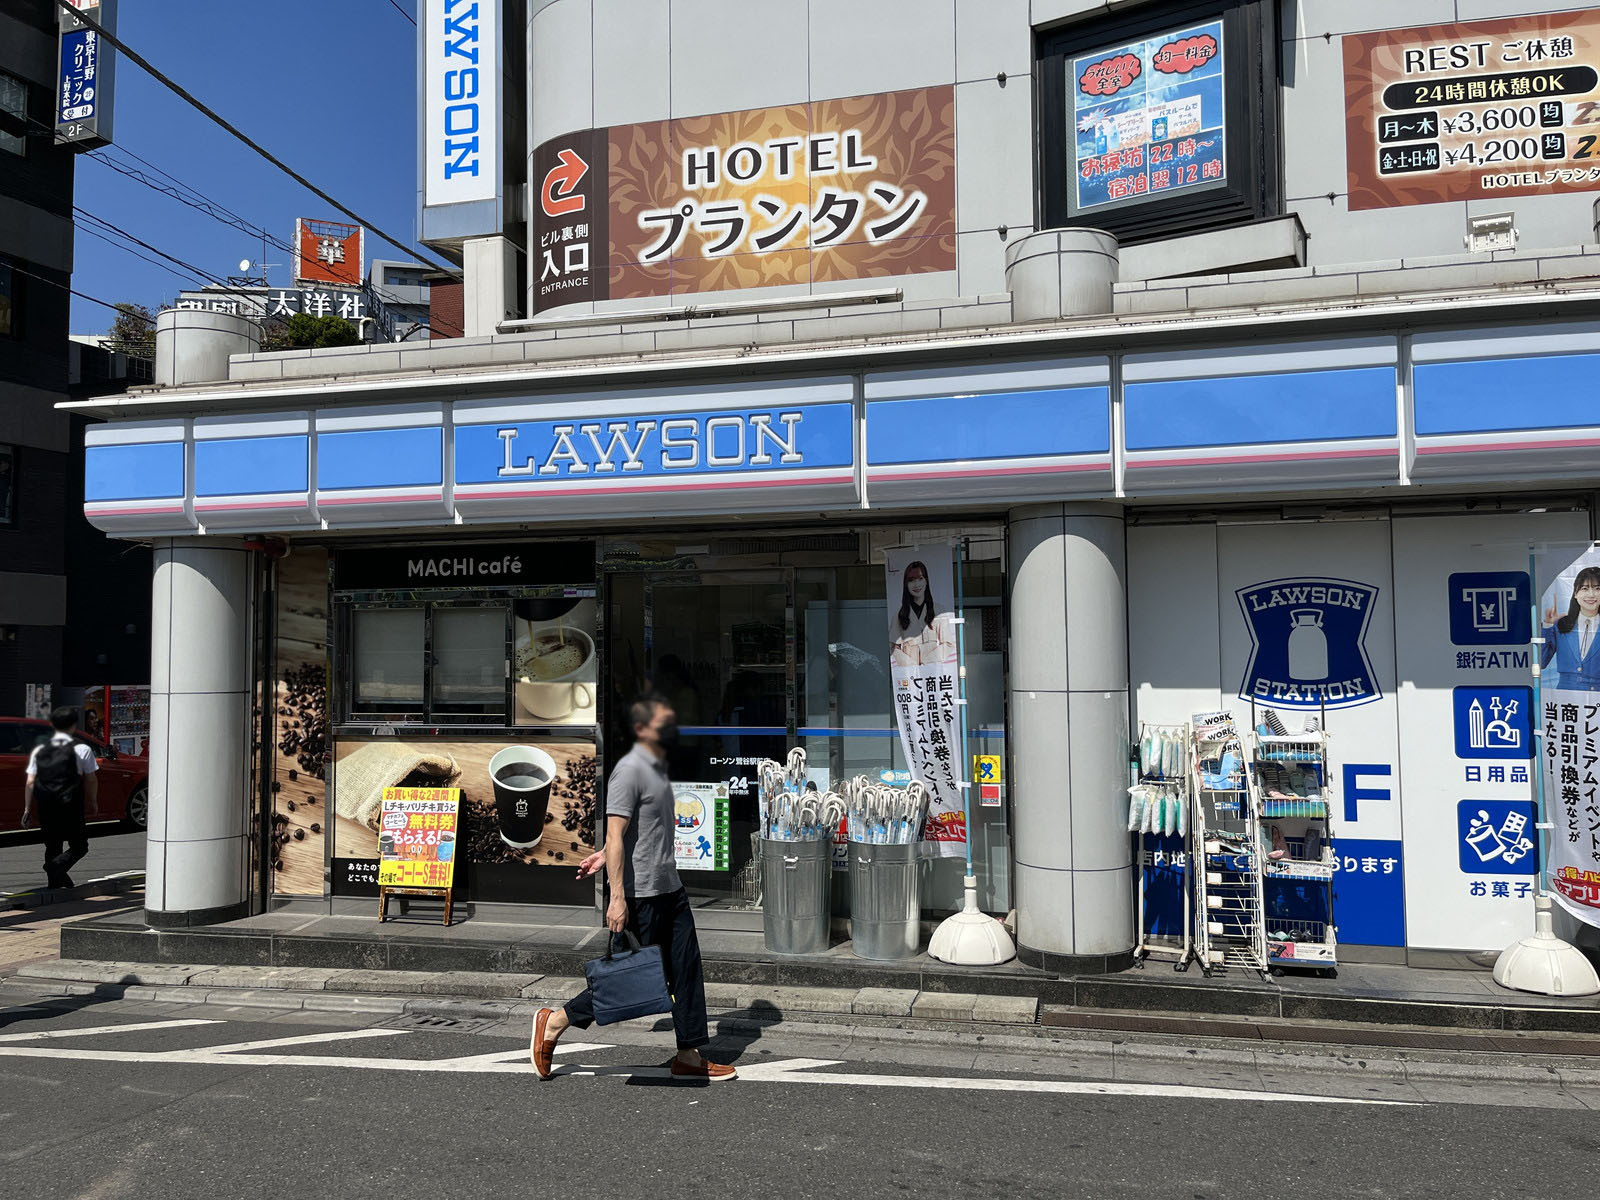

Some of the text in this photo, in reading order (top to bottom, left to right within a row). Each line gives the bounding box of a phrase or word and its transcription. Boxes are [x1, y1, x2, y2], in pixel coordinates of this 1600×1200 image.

[84, 31, 96, 80] 東京上野
[1158, 44, 1213, 63] 均一料金
[1404, 36, 1575, 74] REST ご休憩
[73, 43, 84, 105] クリニック
[1086, 60, 1135, 79] うれしい!
[444, 0, 479, 180] WSON
[1097, 75, 1122, 91] 全室
[1414, 73, 1566, 104] 24時間休憩OK
[68, 125, 83, 137] 2F
[1442, 105, 1537, 136] ¥3,600
[686, 134, 873, 186] HOTEL
[1081, 147, 1143, 178] お寝坊
[1150, 143, 1174, 164] 22
[1444, 137, 1539, 167] ¥4,200
[1108, 172, 1148, 199] 宿泊
[1177, 165, 1198, 185] 12
[1202, 159, 1222, 178] 時
[541, 223, 589, 248] ビル裏側
[643, 186, 921, 261] プランタン
[540, 242, 589, 282] 入口
[541, 276, 589, 296] ENTRANCE
[270, 291, 366, 320] 太洋社
[496, 411, 804, 478] LAWSON
[407, 556, 522, 577] MACHI café
[1249, 586, 1365, 612] LAWSON
[1456, 651, 1529, 669] 銀行ATM
[1253, 677, 1366, 702] STATION
[1204, 713, 1233, 726] WORK
[1207, 727, 1236, 741] WORK
[1545, 702, 1558, 775] 当たる!
[1221, 743, 1240, 753] ORK
[729, 776, 749, 790] 24
[1465, 766, 1529, 783] 日用品
[1560, 703, 1581, 842] 商品引換券などが
[408, 813, 454, 830] 無料券
[393, 829, 441, 846] もらえる!
[347, 863, 380, 871] あなたの
[1469, 880, 1533, 899] お菓子
